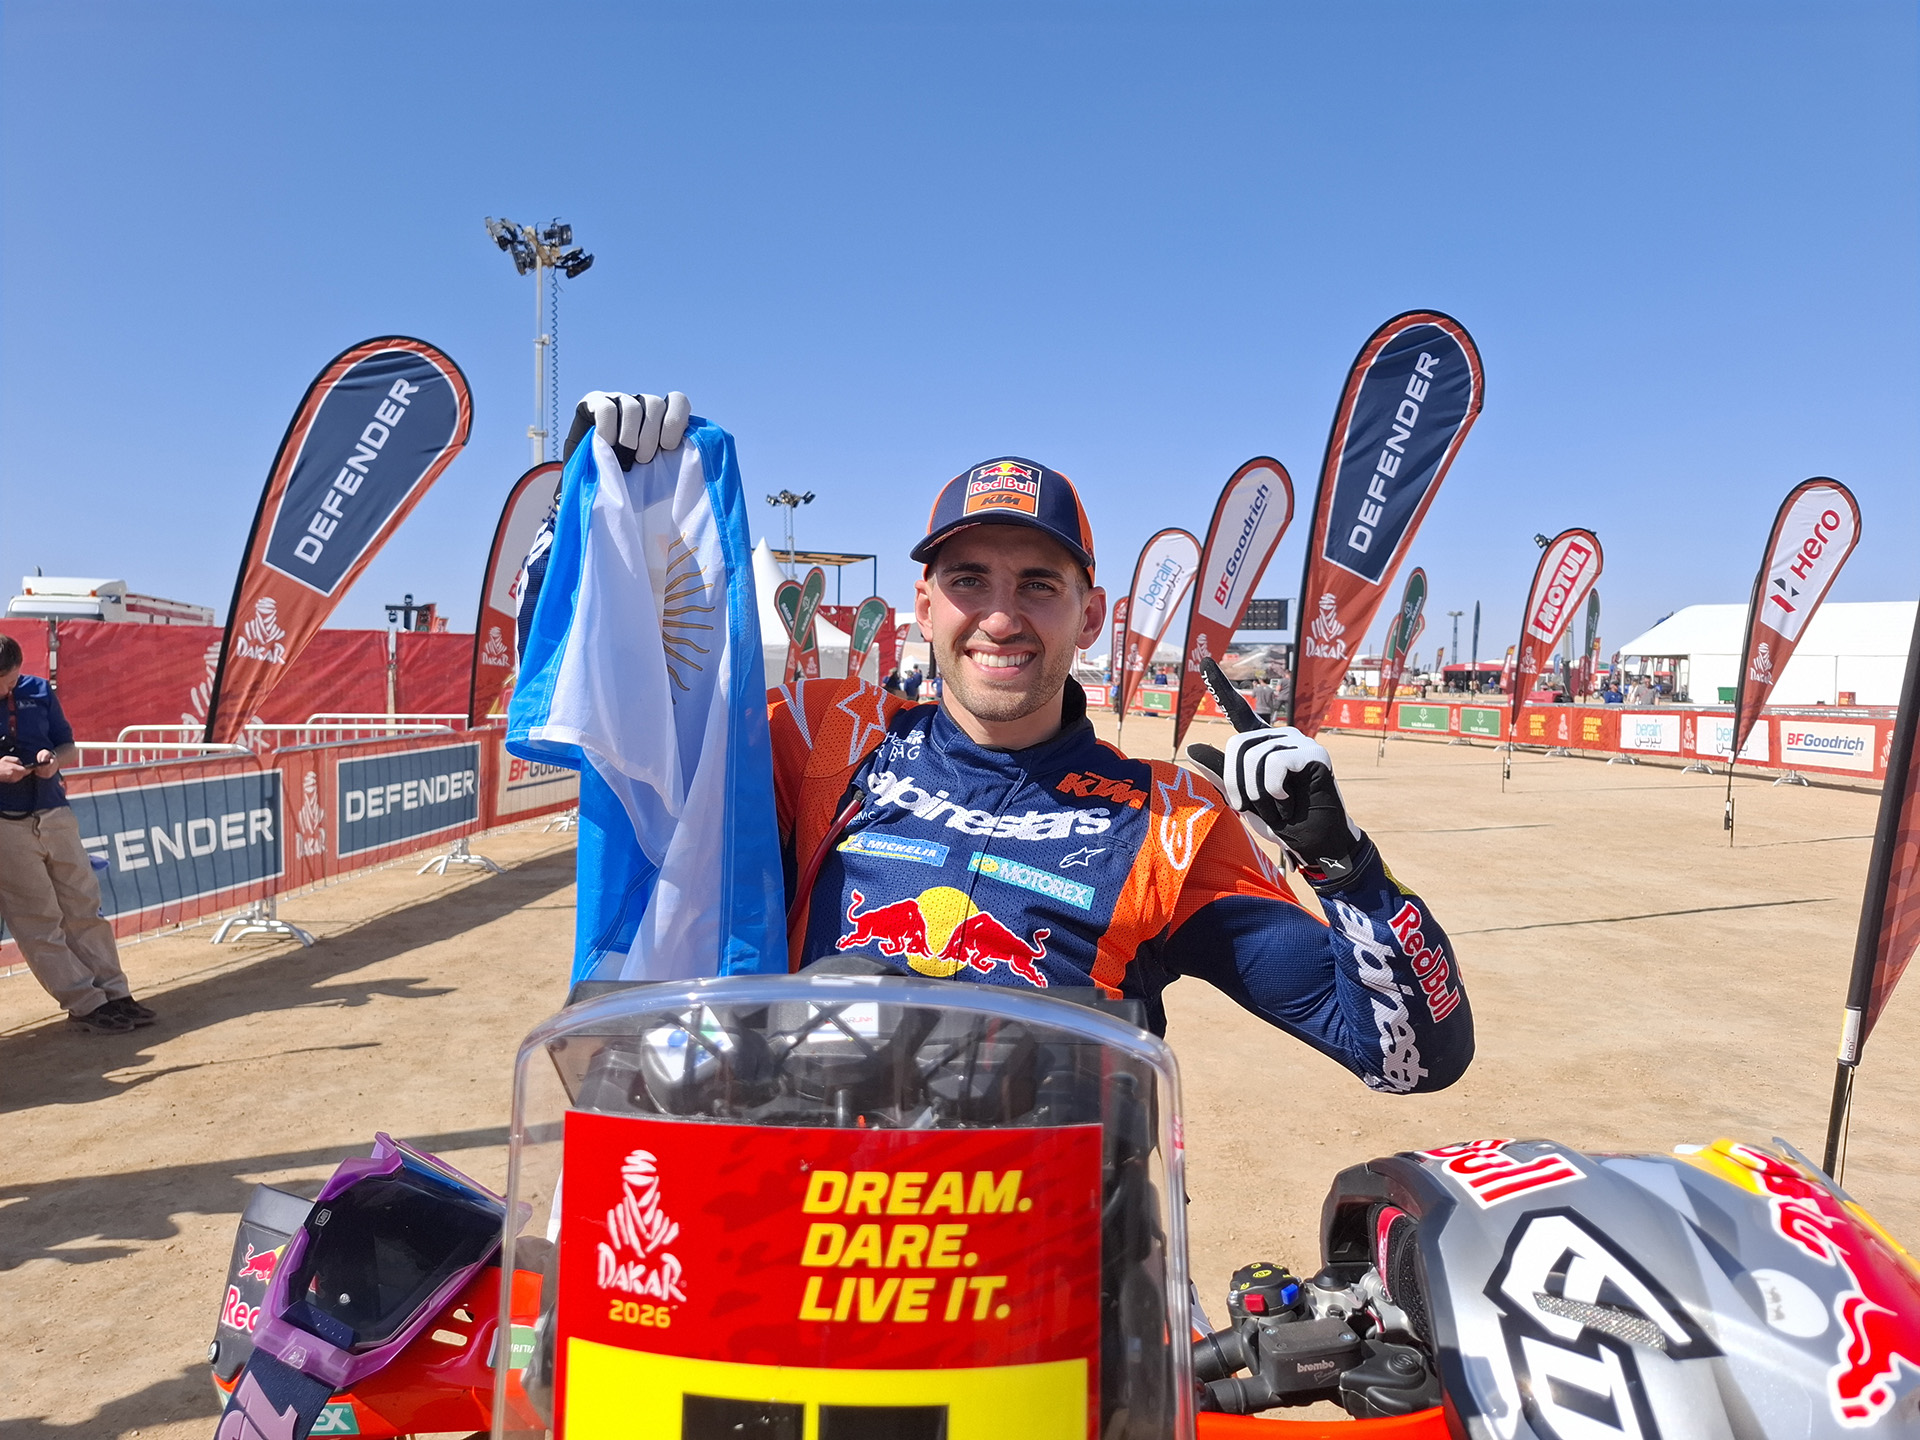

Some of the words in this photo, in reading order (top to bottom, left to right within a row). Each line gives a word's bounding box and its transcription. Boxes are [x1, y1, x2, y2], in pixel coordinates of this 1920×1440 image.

[293, 378, 420, 565] DEFENDER
[1348, 351, 1441, 554] DEFENDER
[970, 476, 1001, 495] Red
[1003, 476, 1037, 496] Bull
[980, 494, 1021, 506] KTM
[1213, 482, 1269, 606] BFGoodrich
[1789, 509, 1841, 581] Hero
[1138, 556, 1177, 607] berain
[1537, 548, 1588, 630] MOTUL
[236, 636, 286, 665] DAKAR
[482, 654, 510, 667] DAKAR
[1305, 636, 1348, 660] DAKAR
[1201, 670, 1220, 702] GOAL
[1635, 719, 1662, 737] berain
[1716, 722, 1735, 741] ber
[1787, 731, 1865, 752] BFGoodrich
[345, 769, 475, 823] DEFENDER
[867, 771, 1111, 841] alpinestars
[1056, 773, 1149, 809] KTM
[81, 807, 275, 872] FENDER
[998, 864, 1089, 905] MOTOREX
[1388, 901, 1440, 979] Red
[1418, 955, 1461, 1023] Bull
[802, 1170, 1033, 1216] DREAM.
[800, 1223, 978, 1268] DARE.
[597, 1242, 688, 1302] DAKAR
[608, 1299, 671, 1329] 2026
[798, 1276, 937, 1323] LIVE
[943, 1275, 1011, 1321] IT.
[1297, 1359, 1335, 1373] brembo
